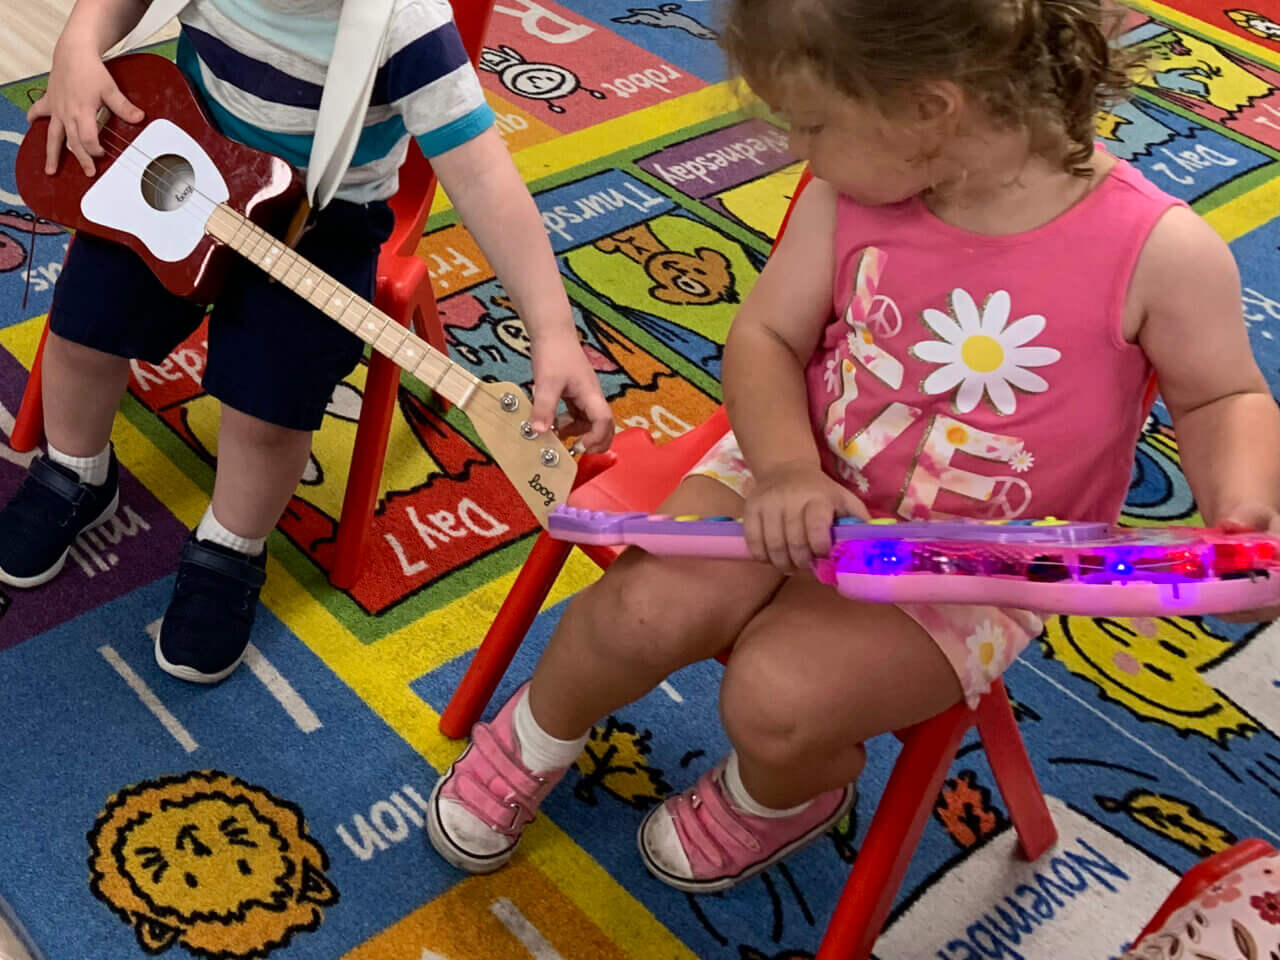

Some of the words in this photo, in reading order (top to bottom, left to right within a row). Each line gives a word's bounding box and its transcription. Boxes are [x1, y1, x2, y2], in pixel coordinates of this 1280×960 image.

[601, 65, 683, 99] robot
[1151, 162, 1196, 185] 2
[1160, 143, 1239, 174] Day
[543, 181, 666, 241] Thursd
[130, 342, 208, 390] day
[615, 405, 696, 438] Da
[528, 474, 556, 506] loog
[406, 496, 511, 550] Day
[384, 531, 427, 577] 7
